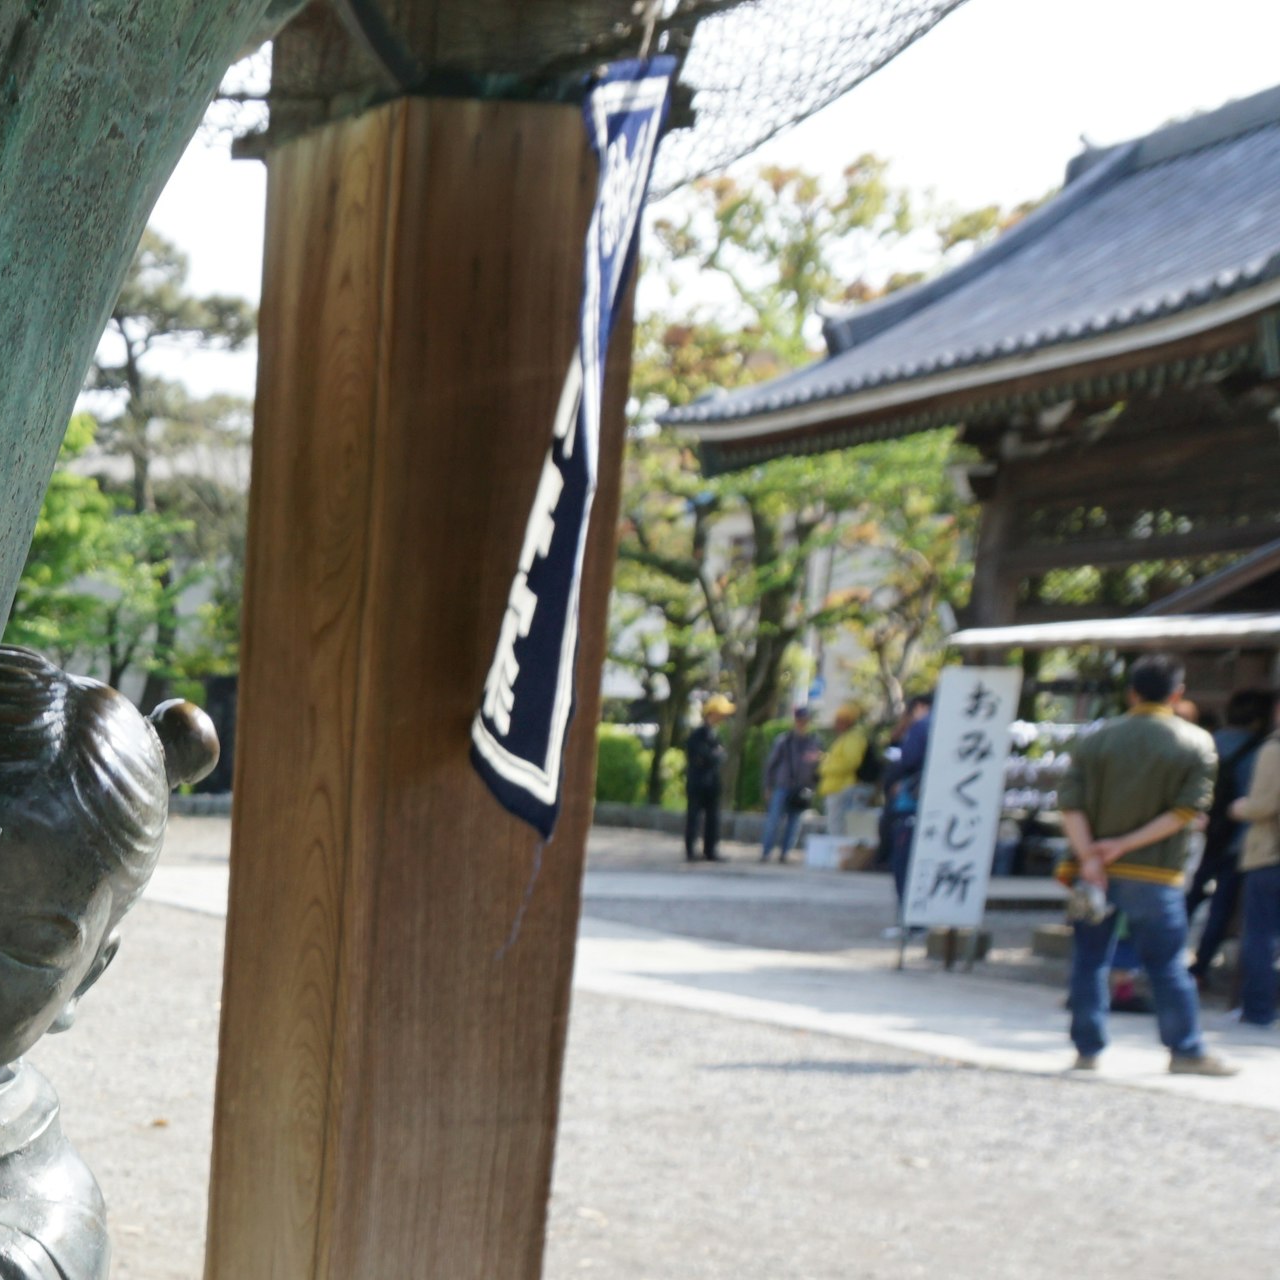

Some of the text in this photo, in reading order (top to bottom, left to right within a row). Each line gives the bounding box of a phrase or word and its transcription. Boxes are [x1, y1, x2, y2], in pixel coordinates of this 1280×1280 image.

[929, 682, 1001, 903] おみくじ所
